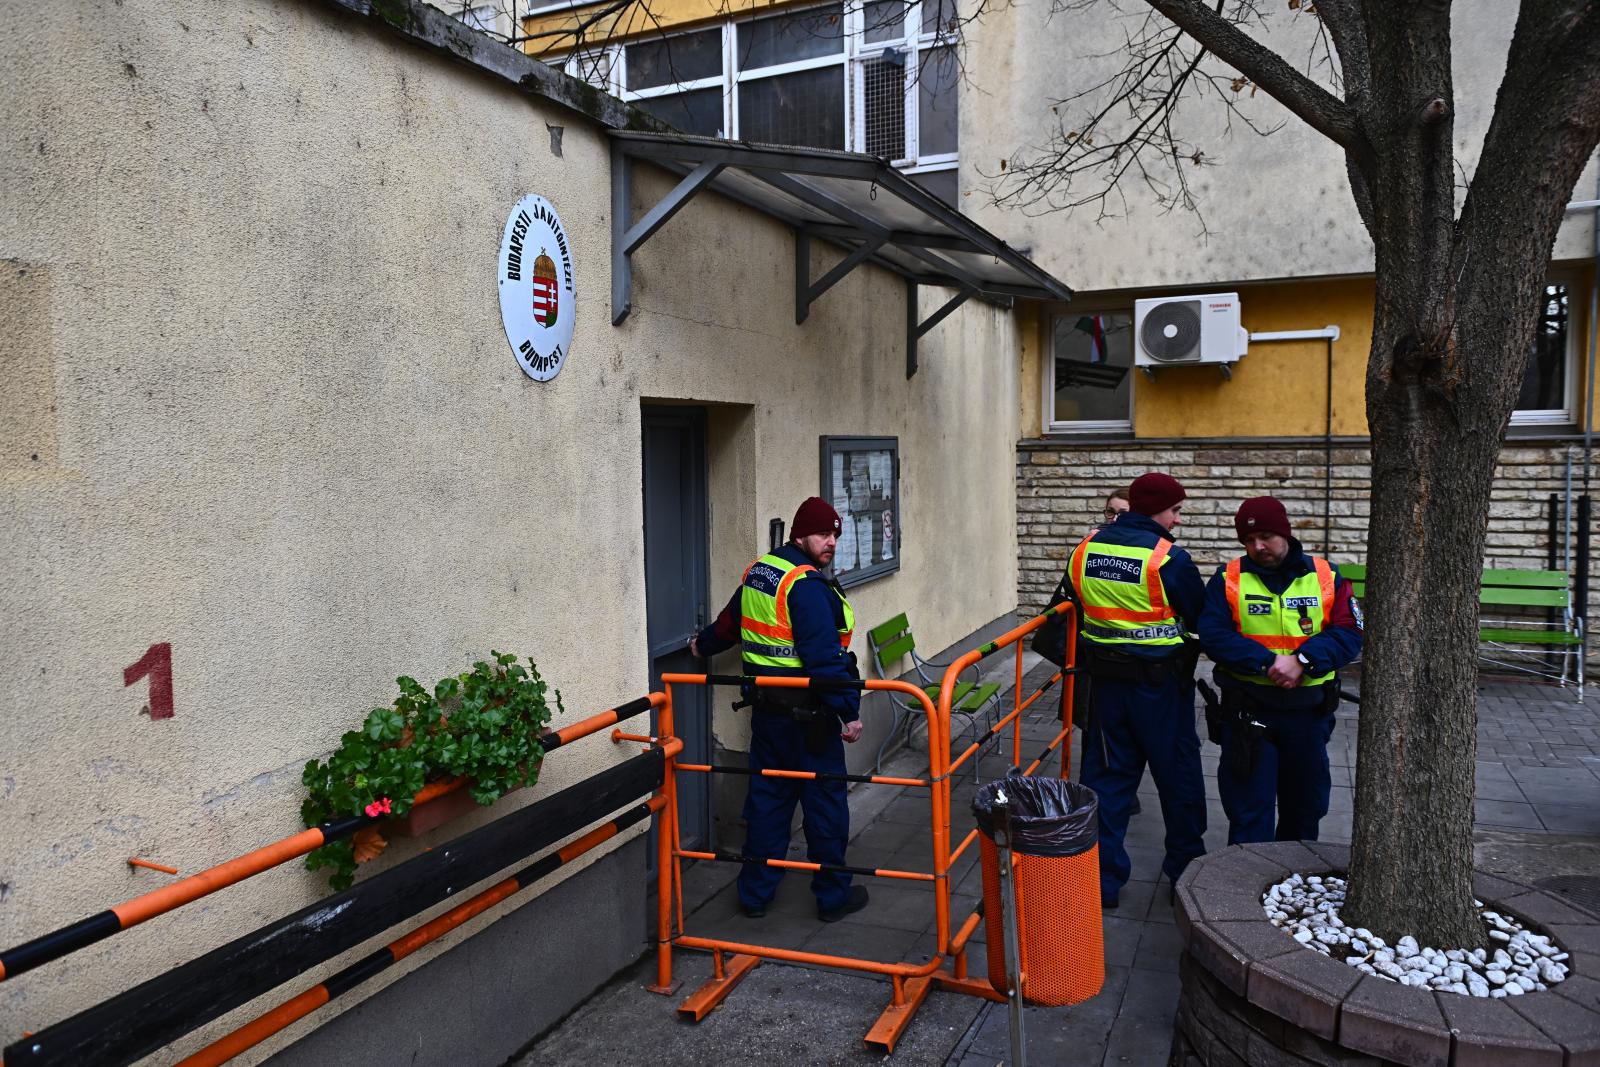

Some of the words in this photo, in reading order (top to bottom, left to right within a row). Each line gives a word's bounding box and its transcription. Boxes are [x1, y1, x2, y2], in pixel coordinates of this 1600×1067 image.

[507, 209, 532, 281] BUDAPESTI
[519, 339, 563, 373] BUDAPEST
[1086, 557, 1141, 576] RENDŐRSÉG
[1099, 570, 1121, 580] POLICE
[1286, 598, 1318, 607] POLICE
[123, 641, 175, 721] 1
